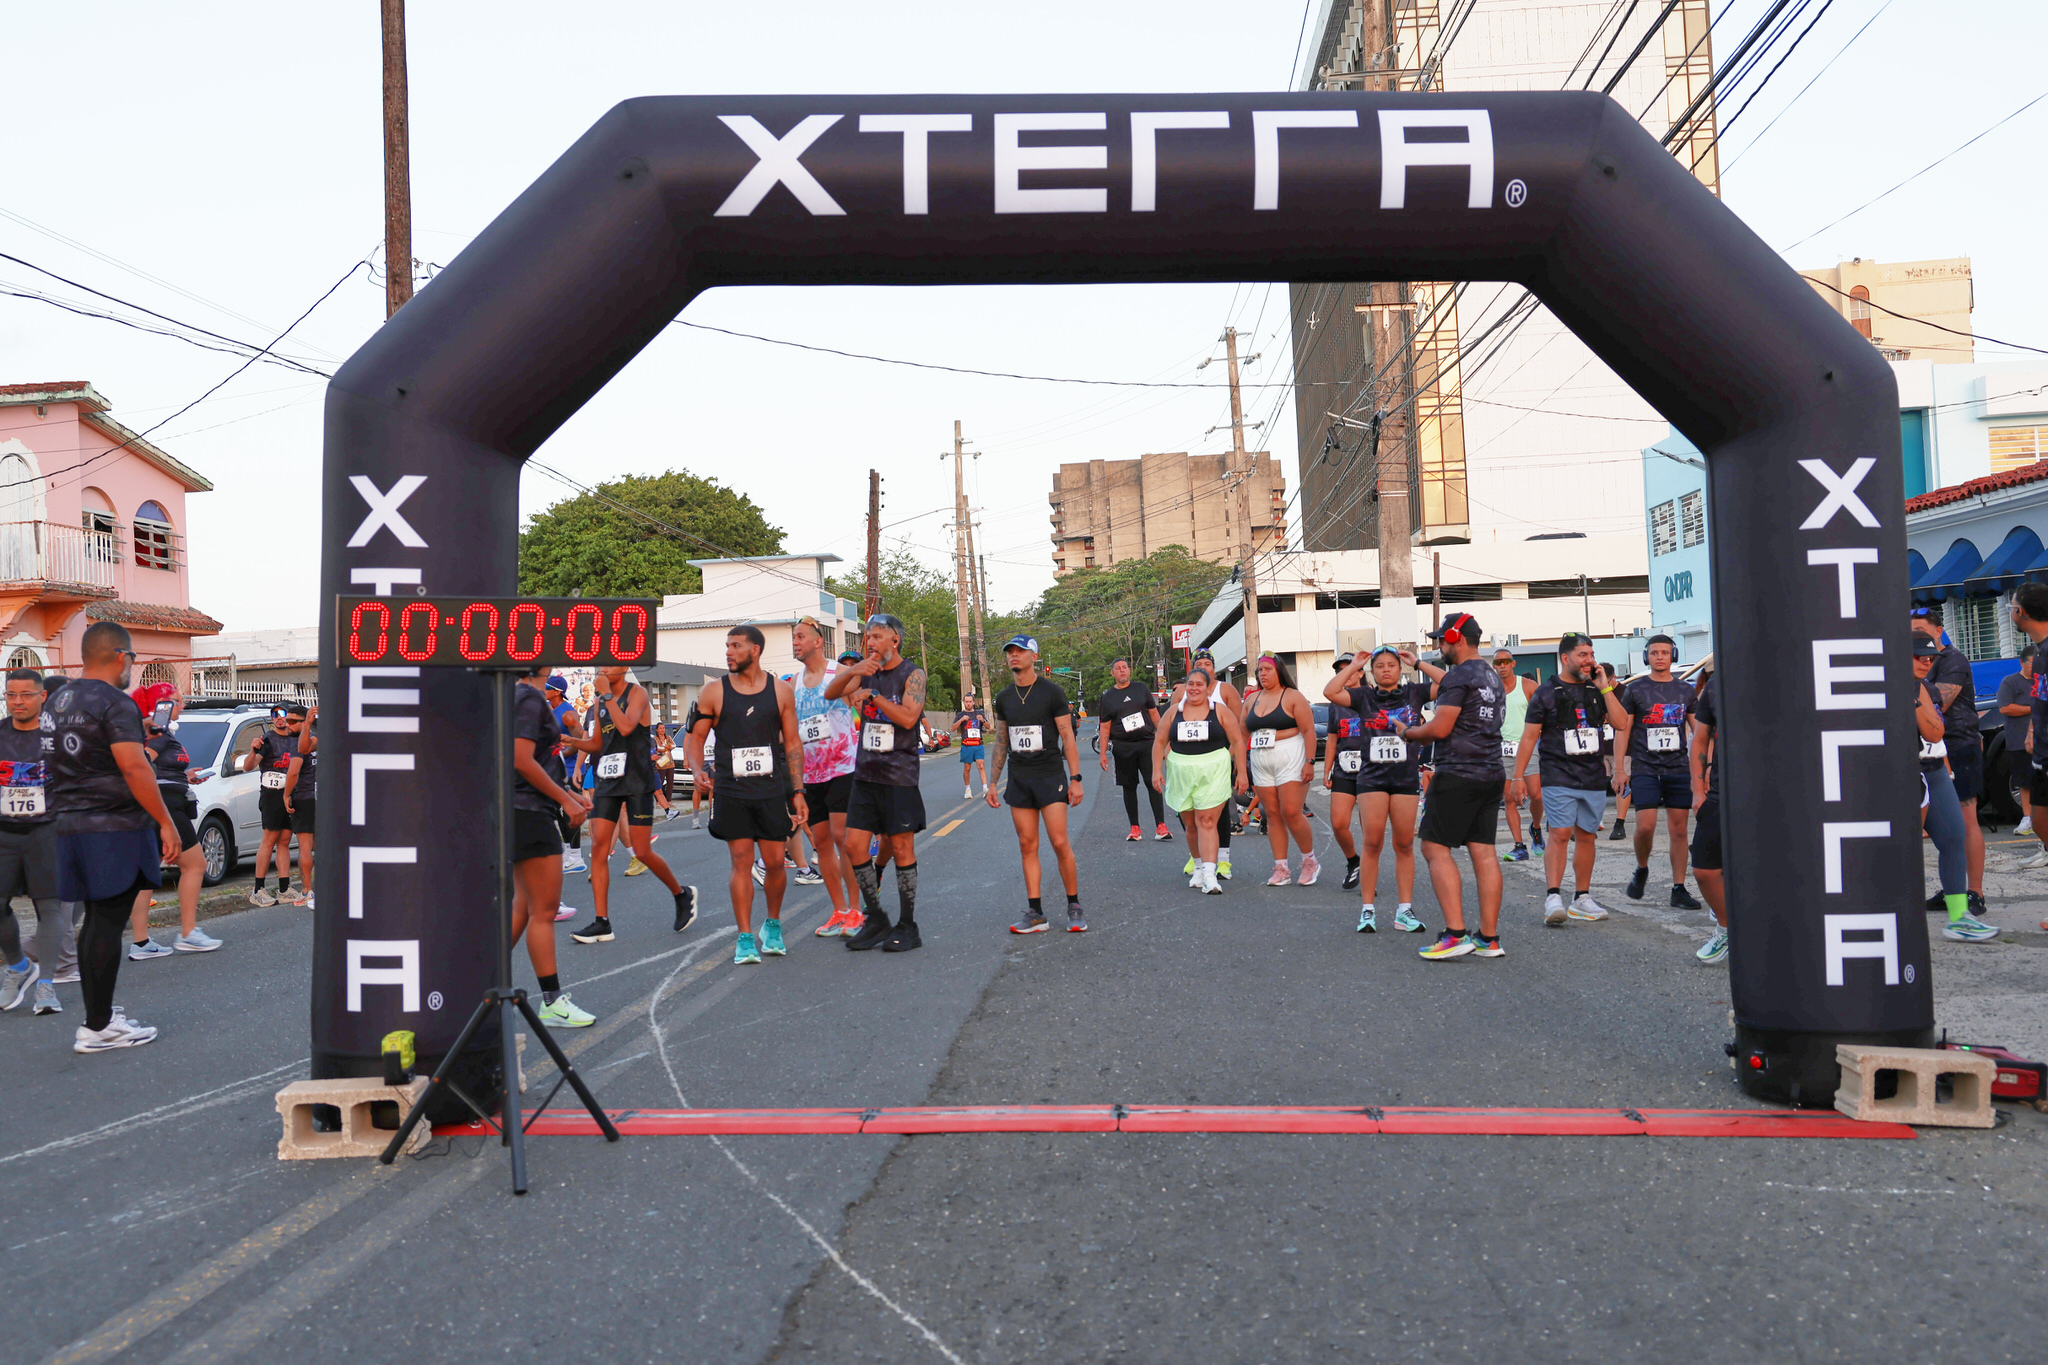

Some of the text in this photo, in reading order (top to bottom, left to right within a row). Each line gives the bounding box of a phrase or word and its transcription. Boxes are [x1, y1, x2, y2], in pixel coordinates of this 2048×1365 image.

[1650, 704, 1680, 719] 5K
[807, 726, 819, 738] 85
[1187, 729, 1199, 738] 54
[870, 735, 881, 747] 15
[1018, 737, 1031, 748] 40
[1255, 737, 1269, 746] 157
[1659, 738, 1671, 747] 17
[1378, 748, 1399, 758] 116
[1504, 747, 1513, 755] 64
[1926, 743, 1932, 754] 7
[603, 764, 618, 775] 158
[745, 760, 761, 771] 86
[1350, 760, 1356, 769] 6
[9, 800, 35, 812] 176
